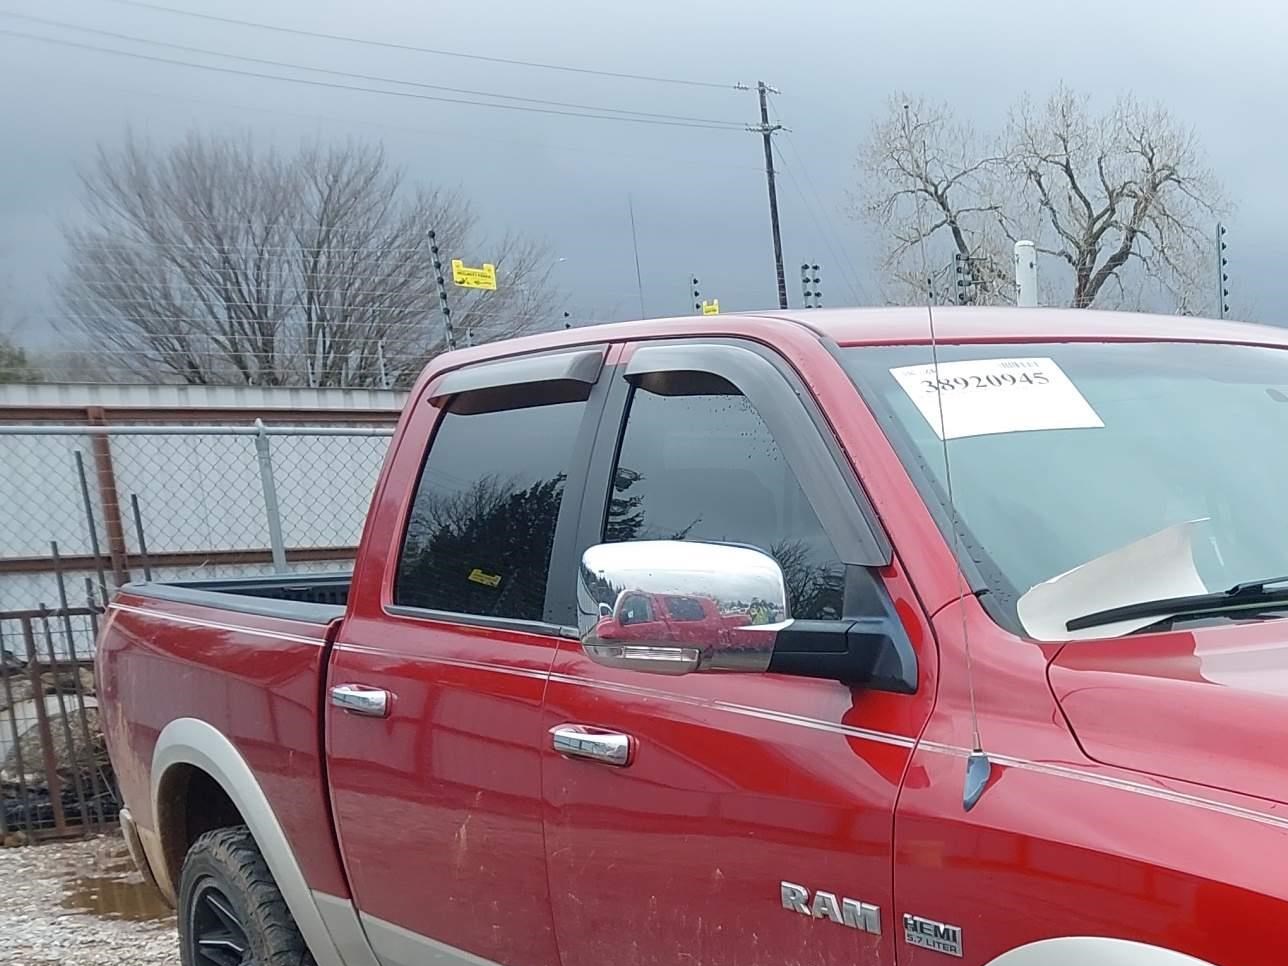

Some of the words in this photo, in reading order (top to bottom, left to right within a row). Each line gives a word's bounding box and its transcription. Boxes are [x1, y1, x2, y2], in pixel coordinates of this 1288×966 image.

[921, 372, 1050, 393] 38920945
[780, 880, 882, 936] RAM
[903, 913, 962, 944] HEMI
[906, 933, 922, 945] 5.7
[925, 938, 959, 954] LITER
